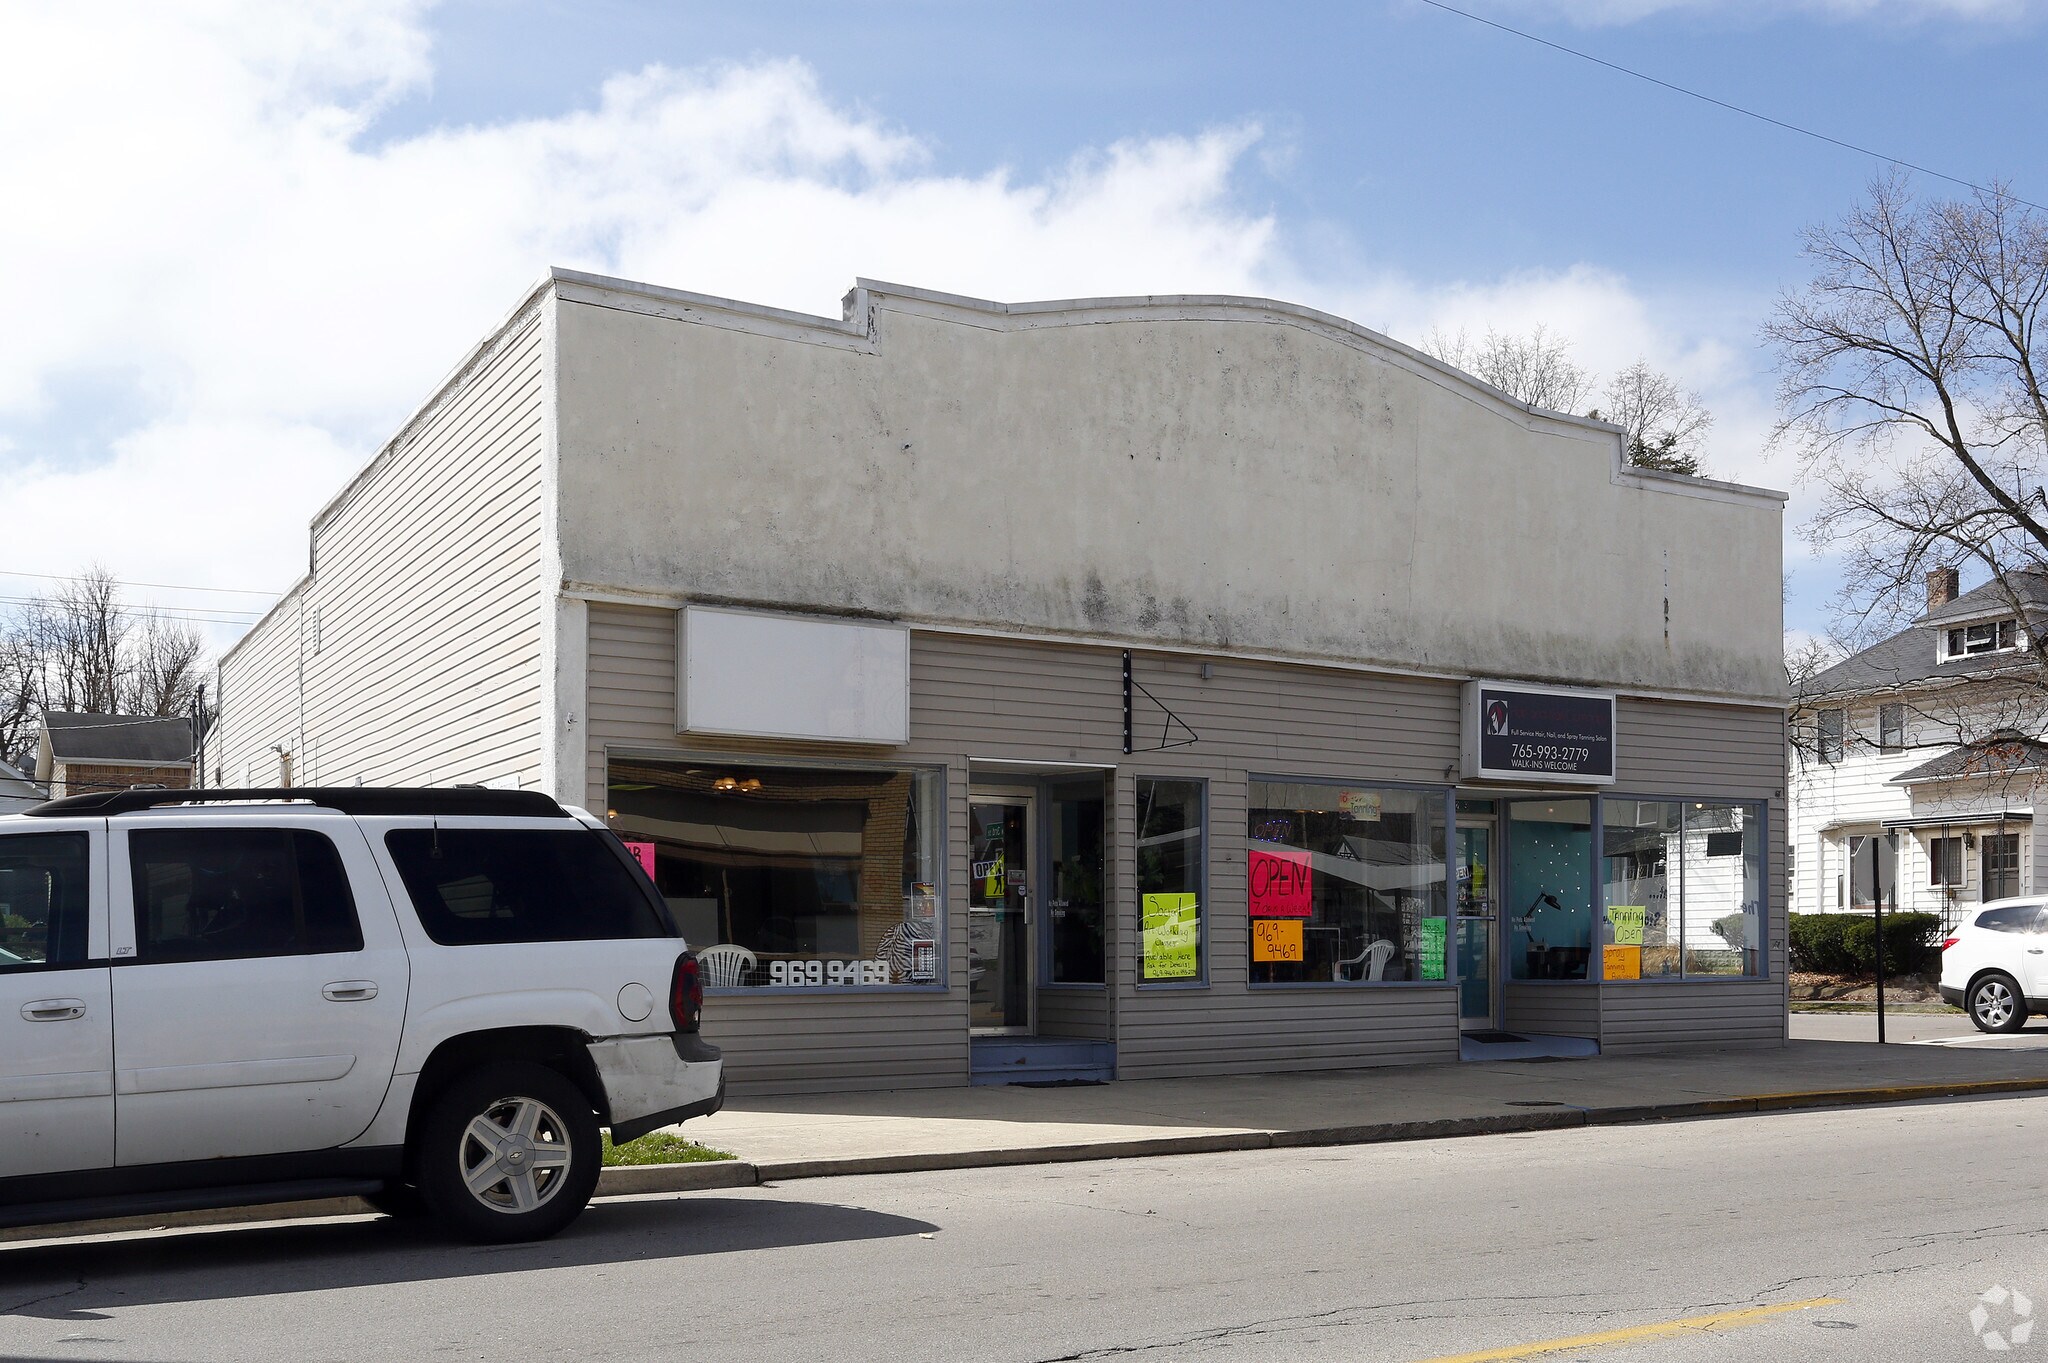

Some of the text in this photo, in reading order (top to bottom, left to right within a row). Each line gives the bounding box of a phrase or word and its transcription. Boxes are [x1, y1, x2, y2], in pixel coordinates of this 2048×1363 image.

[1511, 728, 1519, 736] Full
[1520, 729, 1534, 737] Service
[1567, 732, 1578, 741] Spray
[1579, 733, 1595, 742] Tanning
[1596, 734, 1608, 742] Salon
[1511, 743, 1589, 762] 765-993-2779
[1511, 759, 1578, 771] WALK-INS WELCOME
[1251, 856, 1309, 898] OPEN
[1267, 944, 1297, 959] 9469
[770, 960, 890, 986] 969 9469
